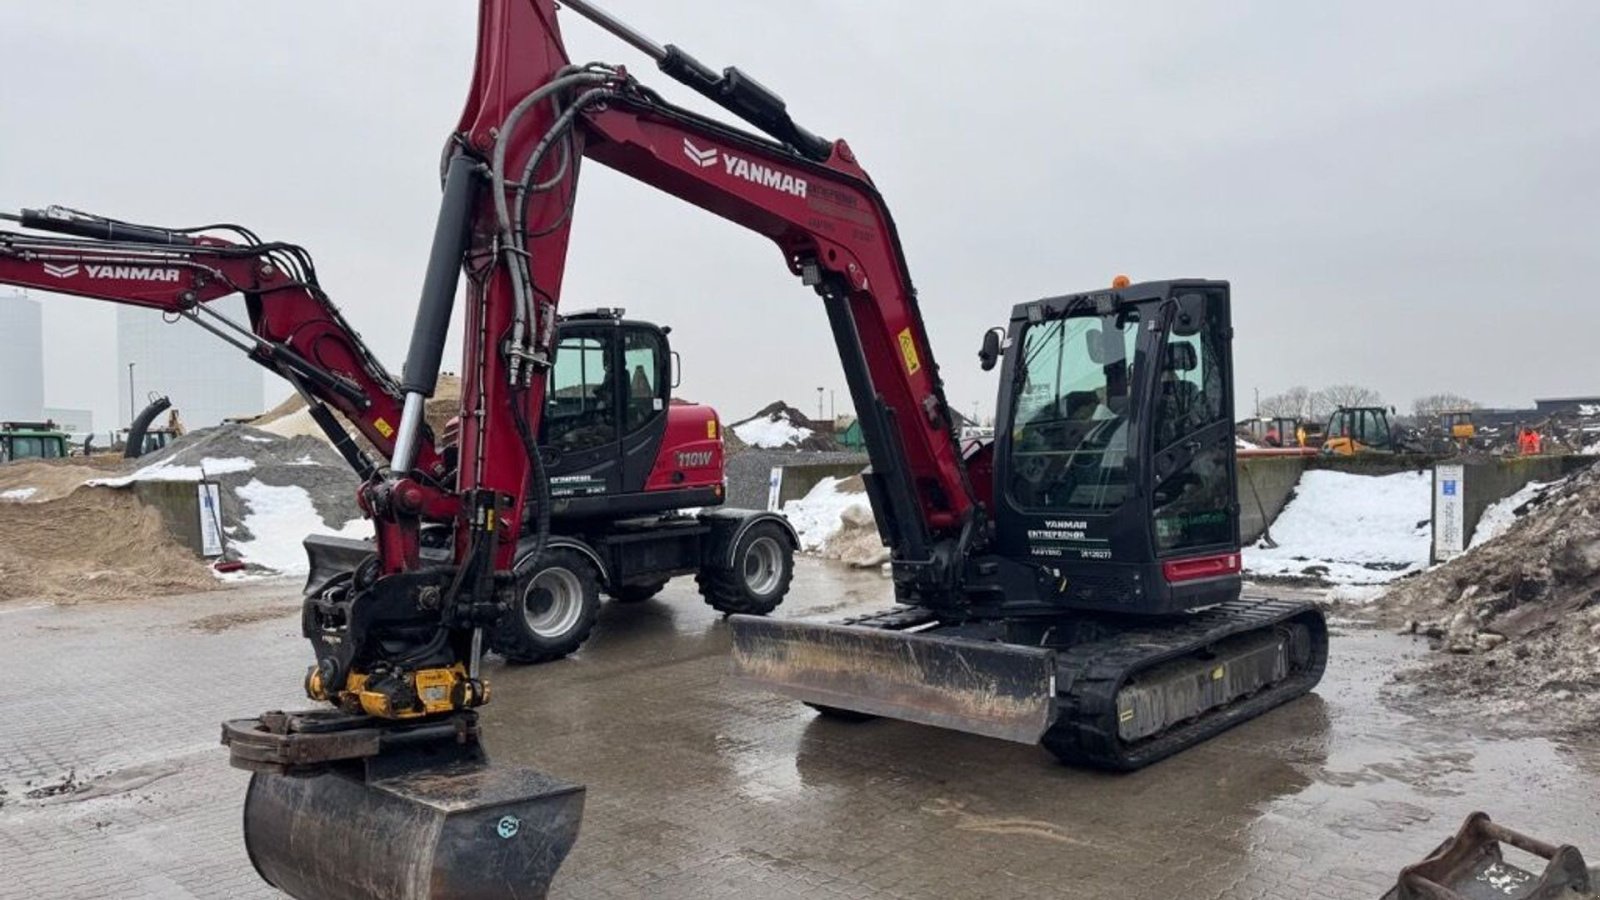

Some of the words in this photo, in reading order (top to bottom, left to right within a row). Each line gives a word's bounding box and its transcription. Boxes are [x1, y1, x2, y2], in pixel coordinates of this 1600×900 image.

[723, 153, 808, 199] YANMAR
[84, 265, 180, 282] YANMAR
[677, 451, 713, 467] 110W
[1045, 520, 1087, 529] YANMAR
